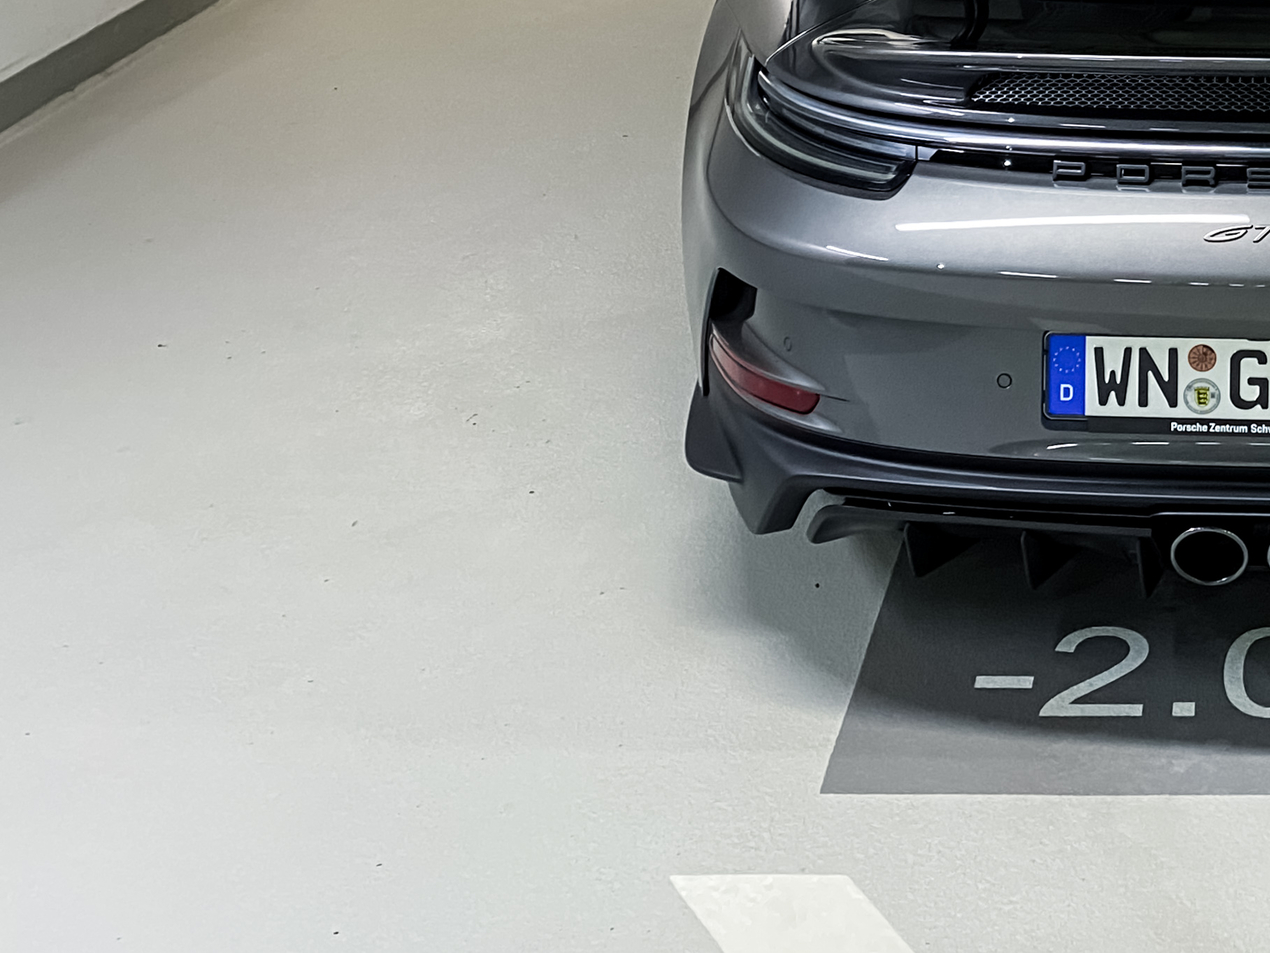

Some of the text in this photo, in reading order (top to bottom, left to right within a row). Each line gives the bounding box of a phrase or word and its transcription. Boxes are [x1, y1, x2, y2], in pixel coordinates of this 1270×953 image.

[1059, 383, 1073, 401] D
[1093, 345, 1179, 408] WN
[1170, 421, 1208, 433] Porsche
[1209, 422, 1248, 434] Zentrum
